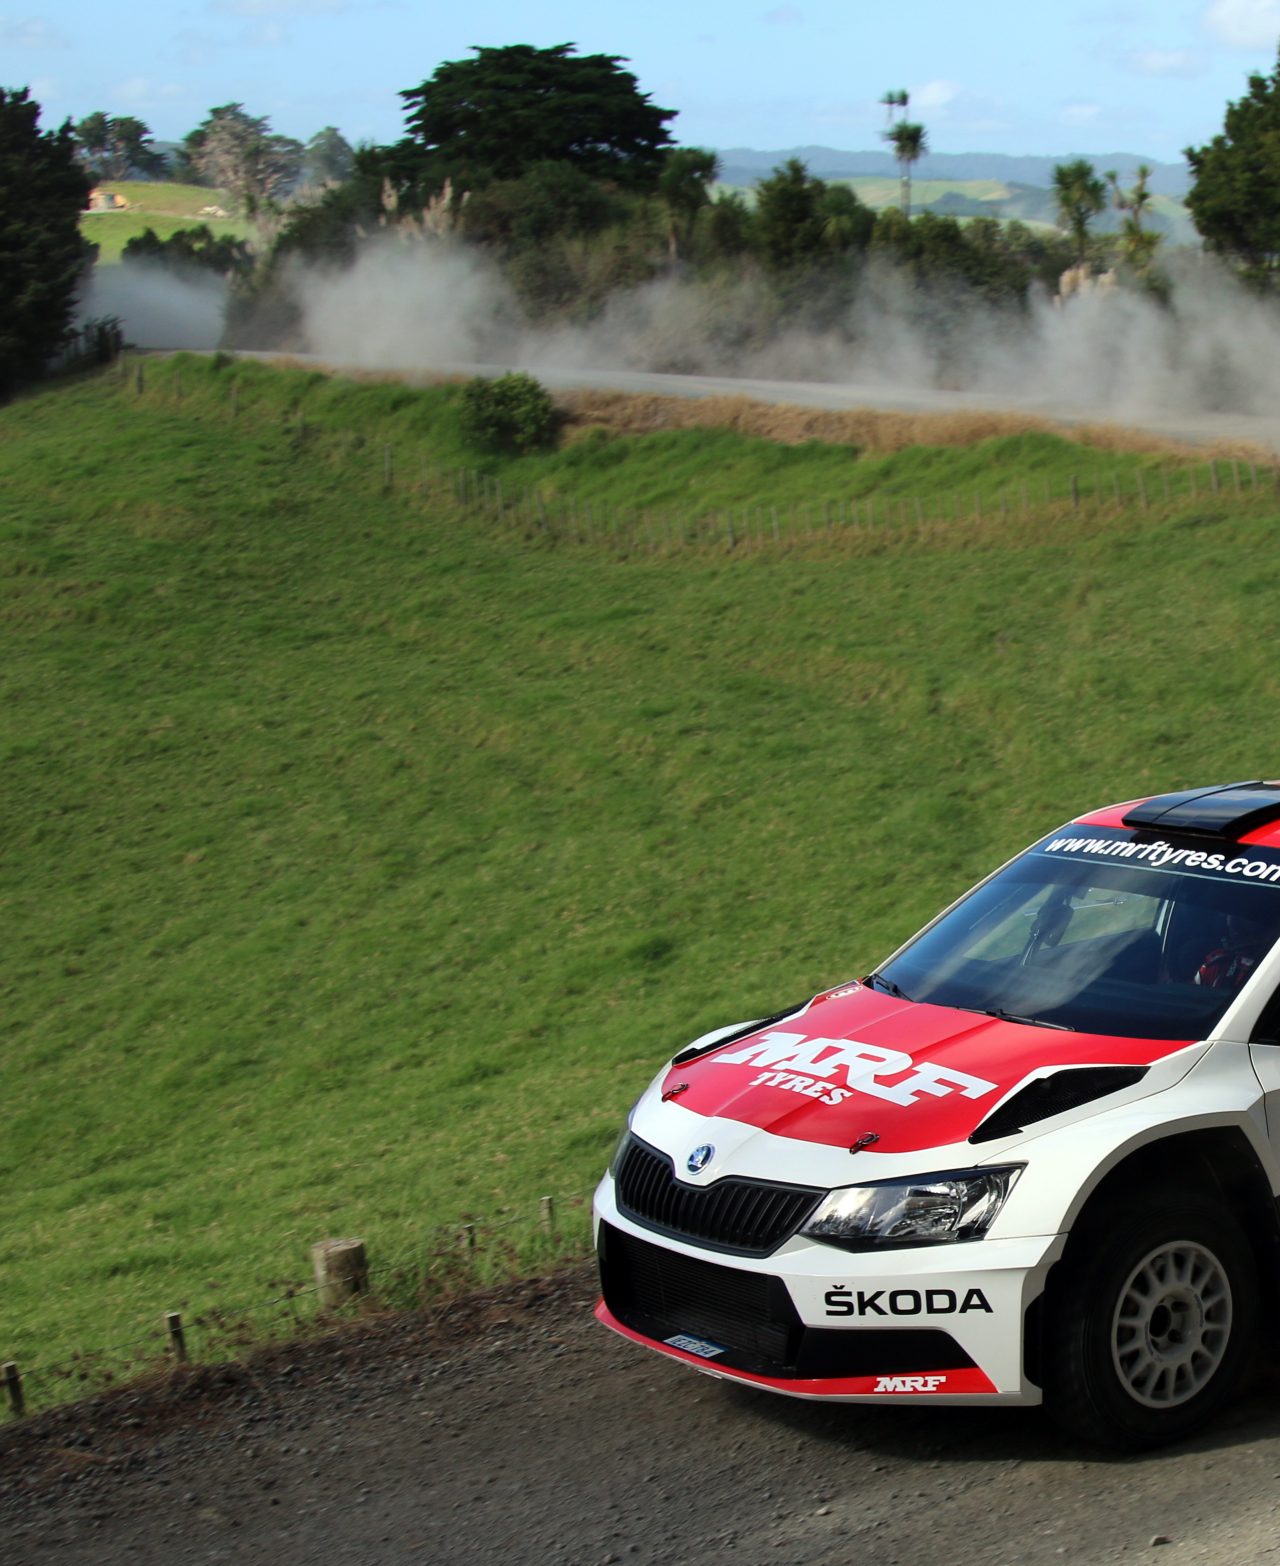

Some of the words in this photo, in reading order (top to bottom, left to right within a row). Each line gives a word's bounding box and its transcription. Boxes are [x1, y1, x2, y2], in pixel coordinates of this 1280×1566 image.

[709, 1032, 999, 1107] MRF
[749, 1071, 853, 1106] TYRES
[824, 1285, 994, 1317] ŠKODA
[873, 1375, 947, 1393] MRF
